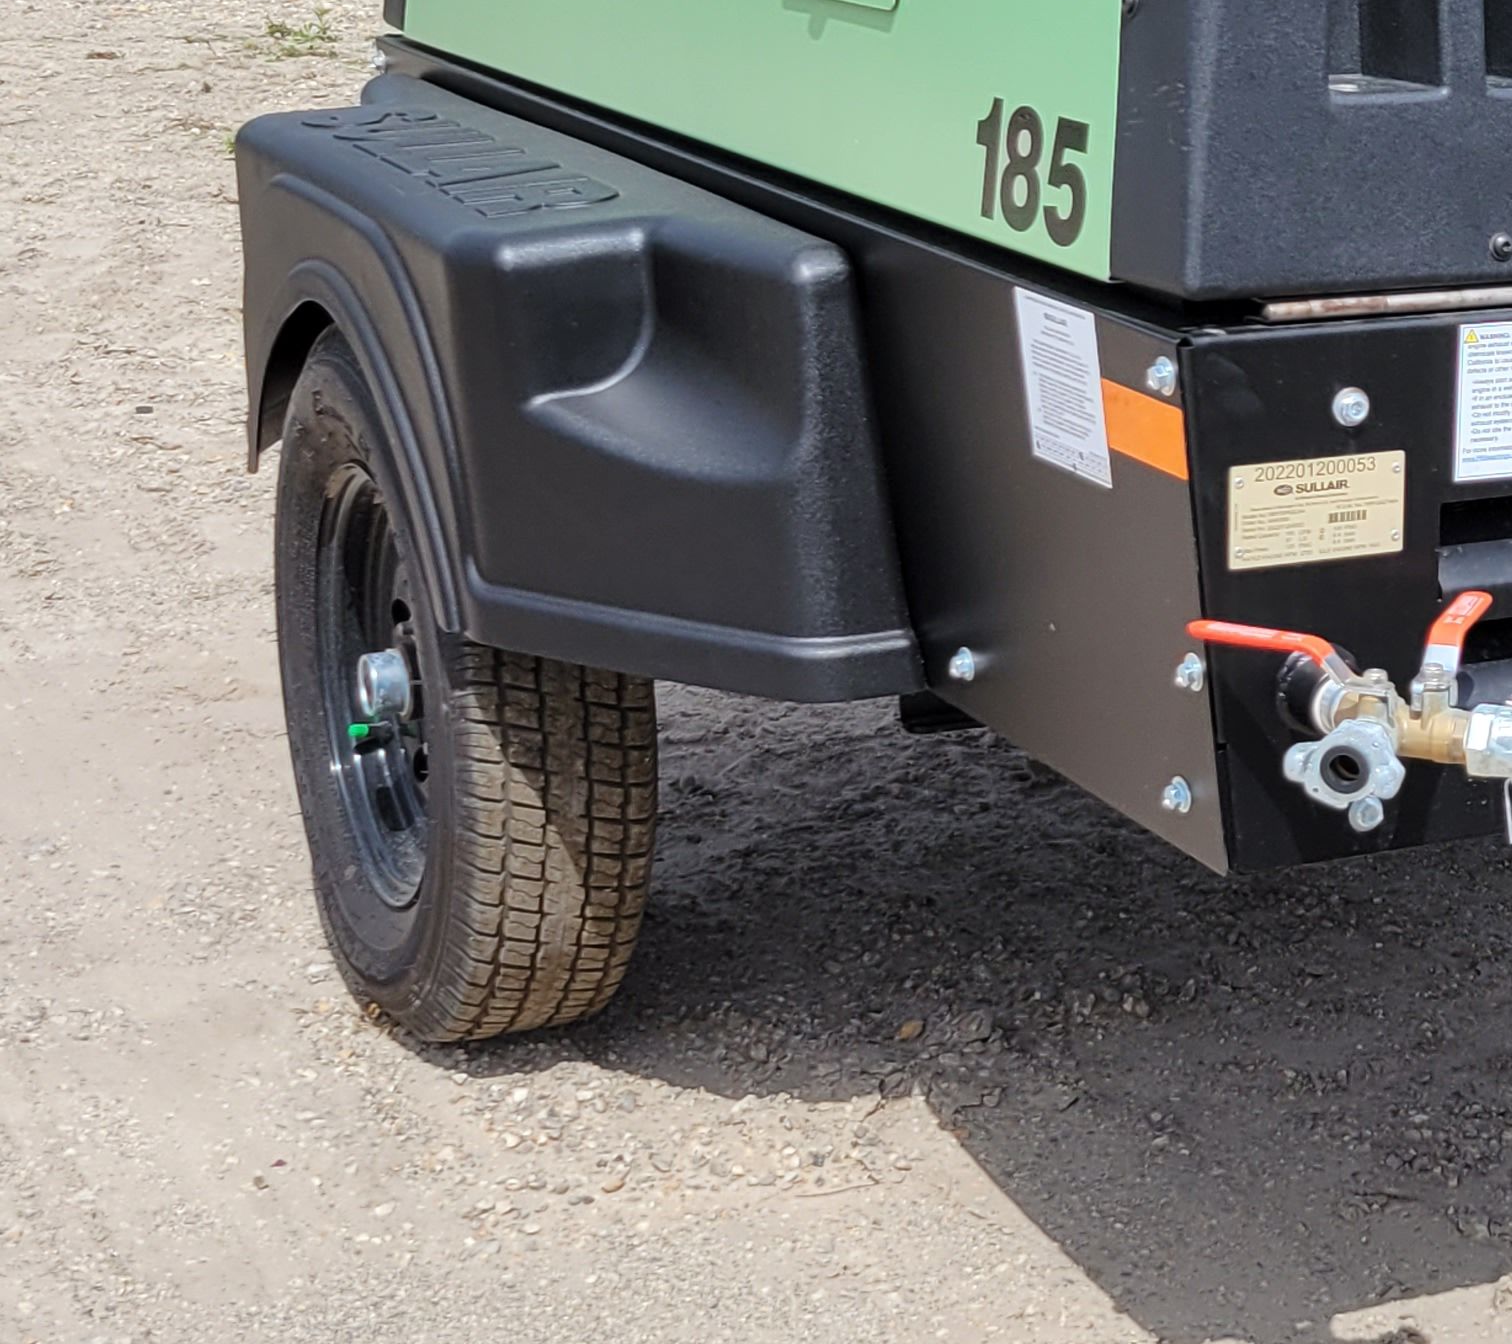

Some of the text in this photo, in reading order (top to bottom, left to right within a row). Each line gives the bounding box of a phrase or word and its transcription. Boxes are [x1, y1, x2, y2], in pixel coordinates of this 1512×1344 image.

[976, 97, 1090, 247] 185
[1254, 456, 1377, 483] 202201200053
[1295, 479, 1350, 495] SULLAIR
